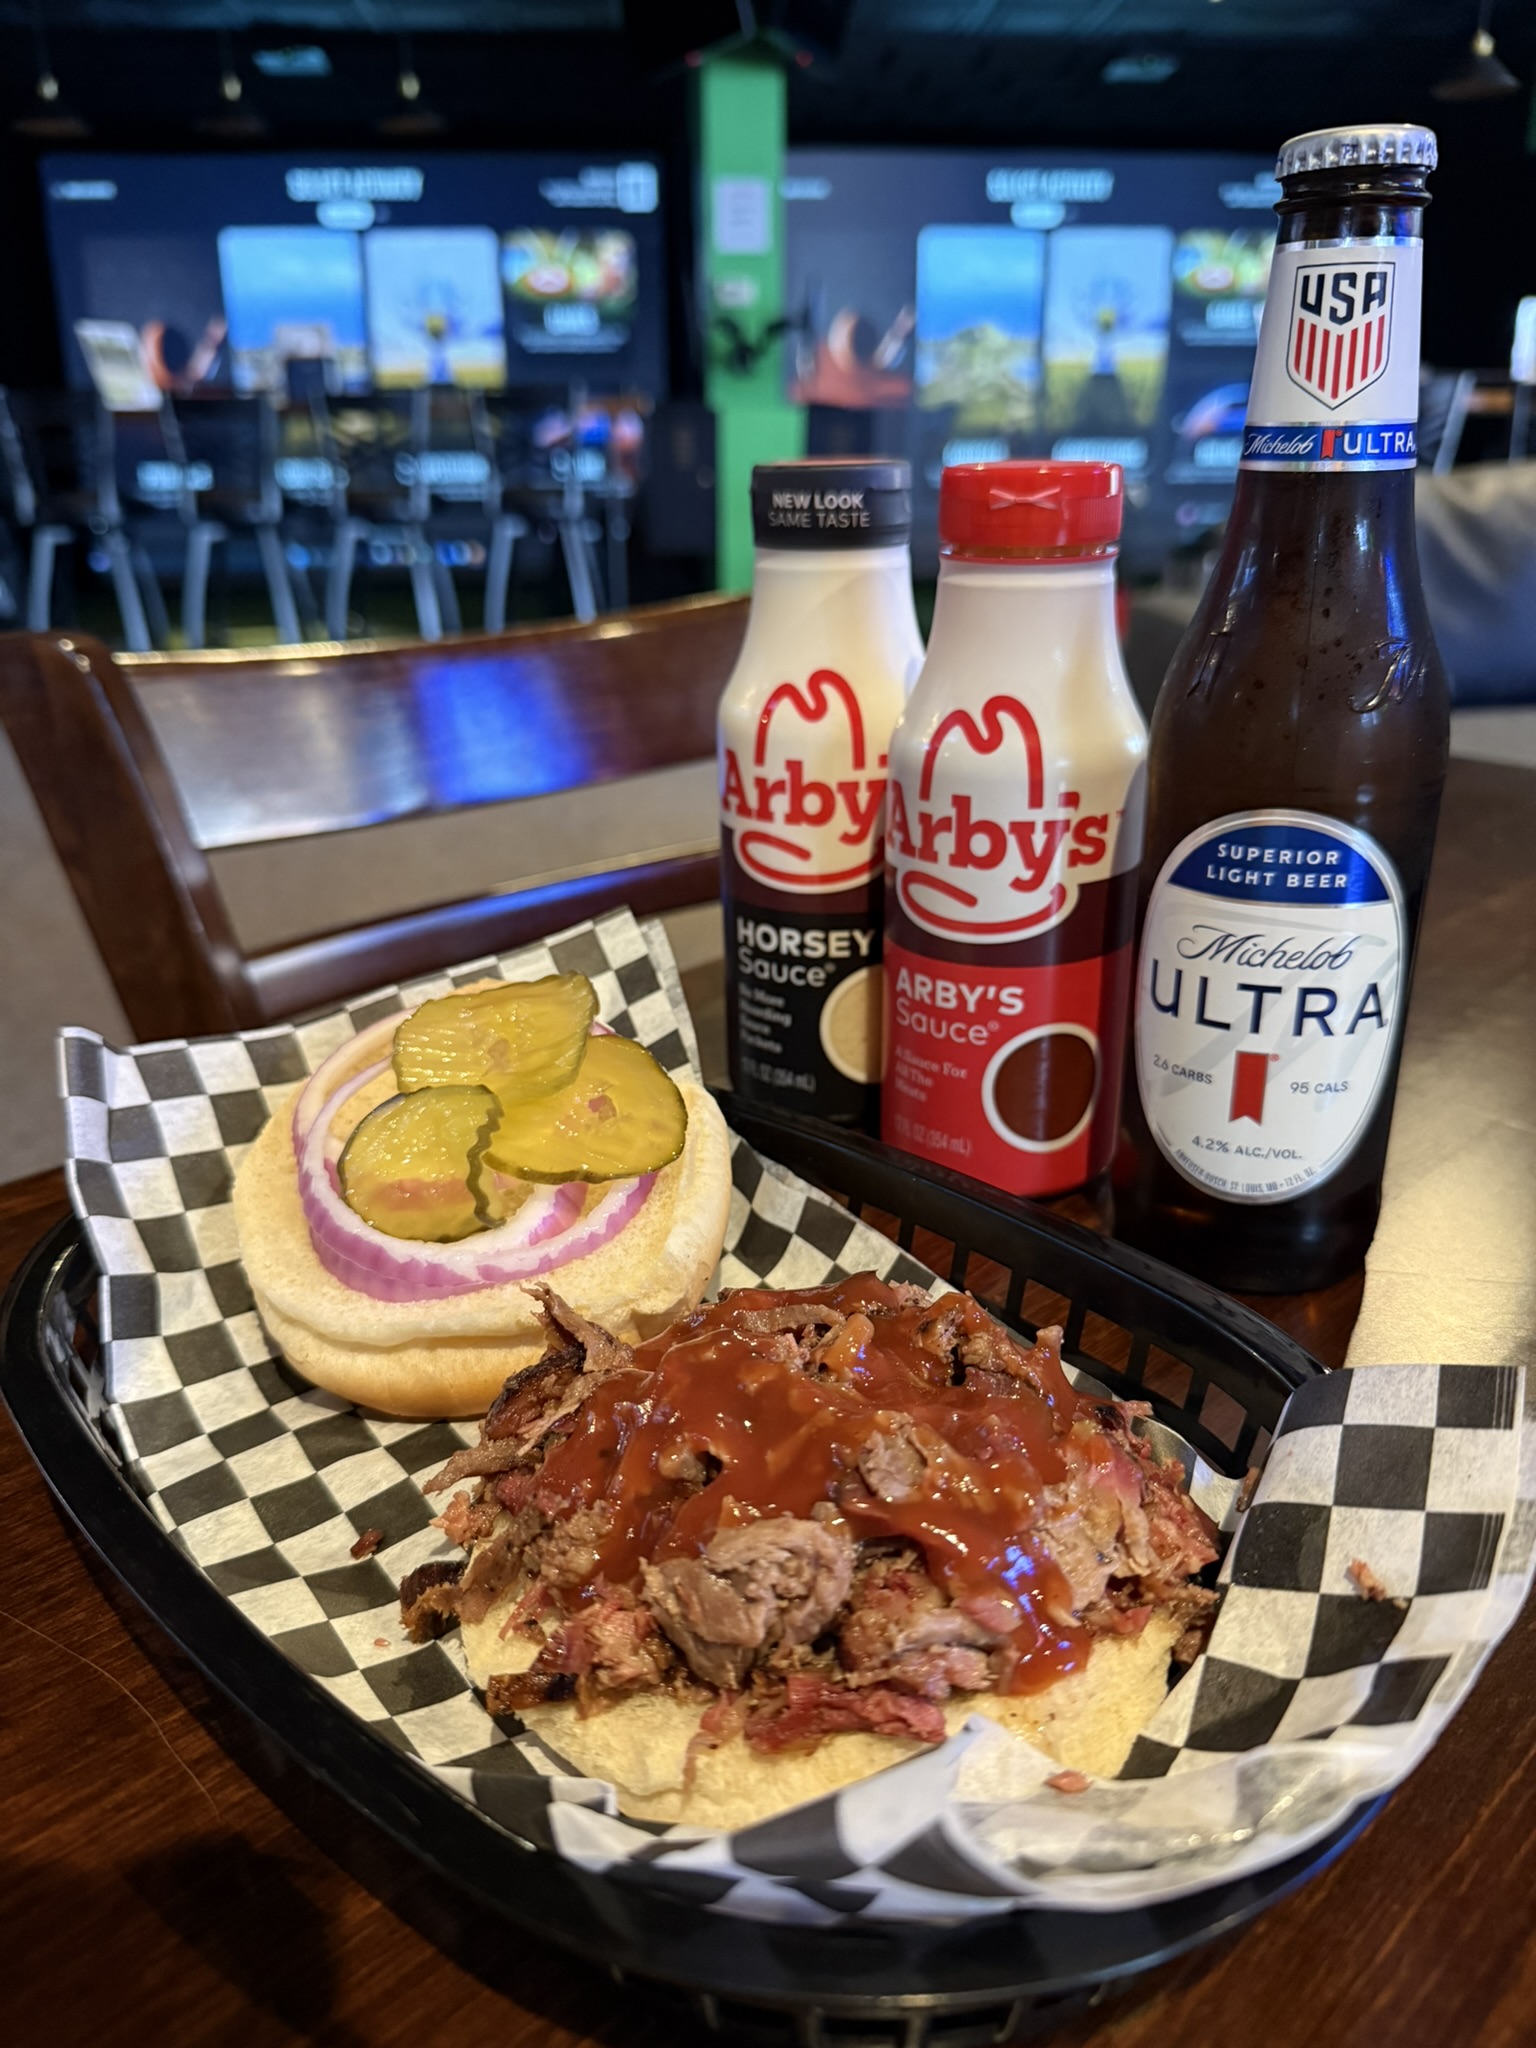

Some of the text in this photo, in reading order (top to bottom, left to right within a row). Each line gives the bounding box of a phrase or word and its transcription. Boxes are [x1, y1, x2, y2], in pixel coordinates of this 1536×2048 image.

[1299, 271, 1388, 325] USA
[1244, 433, 1318, 456] Michelob
[1343, 432, 1415, 454] ULTRA
[771, 492, 864, 510] NEW LOOK
[768, 511, 871, 528] SAME TASTE
[887, 779, 1109, 892] Arby's
[1217, 843, 1341, 866] SUPERIOR
[1206, 864, 1348, 888] LIGHT BEER
[737, 916, 874, 958] HORSEY
[1176, 924, 1360, 971] Michelob
[738, 945, 827, 988] Sauce
[896, 967, 1025, 1016] ARBY'S
[1150, 958, 1384, 1037] ULTRA
[896, 997, 989, 1046] Sauce
[1171, 1064, 1213, 1084] CARBS
[1290, 1081, 1349, 1094] 95 CALS
[1192, 1136, 1303, 1160] 4.2% ALC./VOL.
